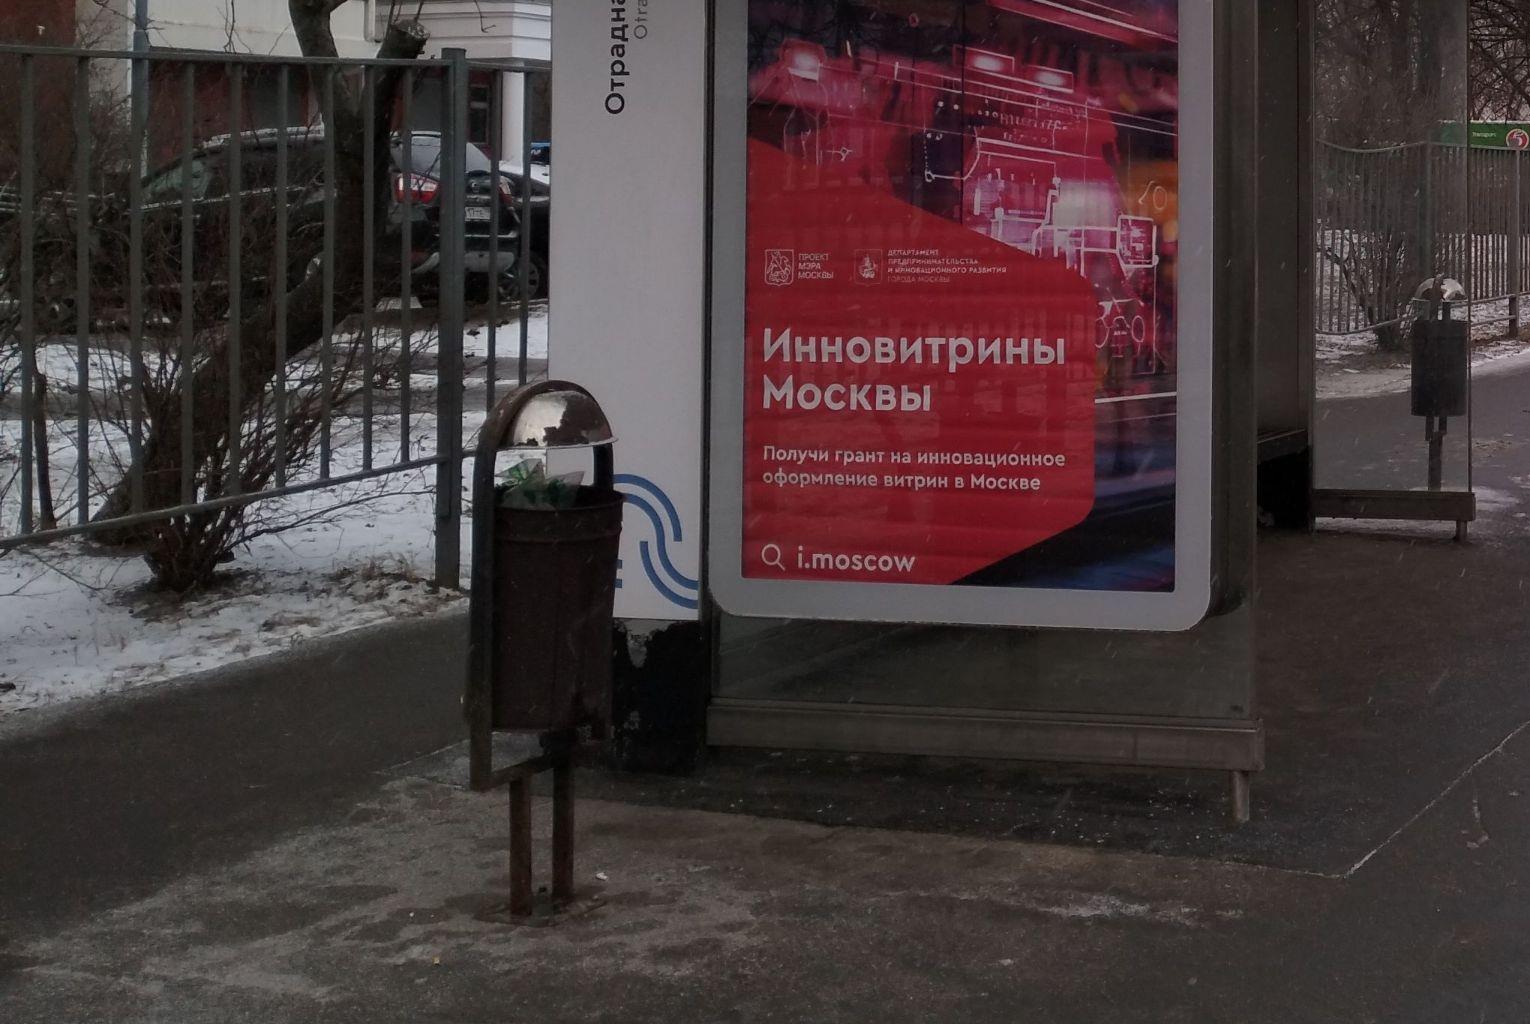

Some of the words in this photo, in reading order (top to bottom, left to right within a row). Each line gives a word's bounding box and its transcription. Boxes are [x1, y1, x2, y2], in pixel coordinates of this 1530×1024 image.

[798, 253, 829, 261] ПРОЕКТ
[887, 249, 939, 257] ДЕПАРТАМЕНТ
[798, 262, 821, 270] МЭРА
[887, 258, 979, 266] ПРЕДПРИНИМАТЕЛЬСТВА
[798, 271, 834, 279] МОСКВЫ
[895, 267, 967, 275] ИННОВАЦИОННОГО
[763, 327, 1066, 373] Инновитрины
[763, 374, 931, 411] Москвы
[763, 445, 829, 464] Получи
[835, 449, 884, 465] грант
[890, 451, 912, 464] на
[917, 452, 1066, 467] инновационное
[763, 468, 878, 487] оформление
[884, 475, 948, 491] витрин
[955, 477, 965, 489] в
[971, 474, 1041, 491] Москве
[797, 545, 916, 573] i.moscow
